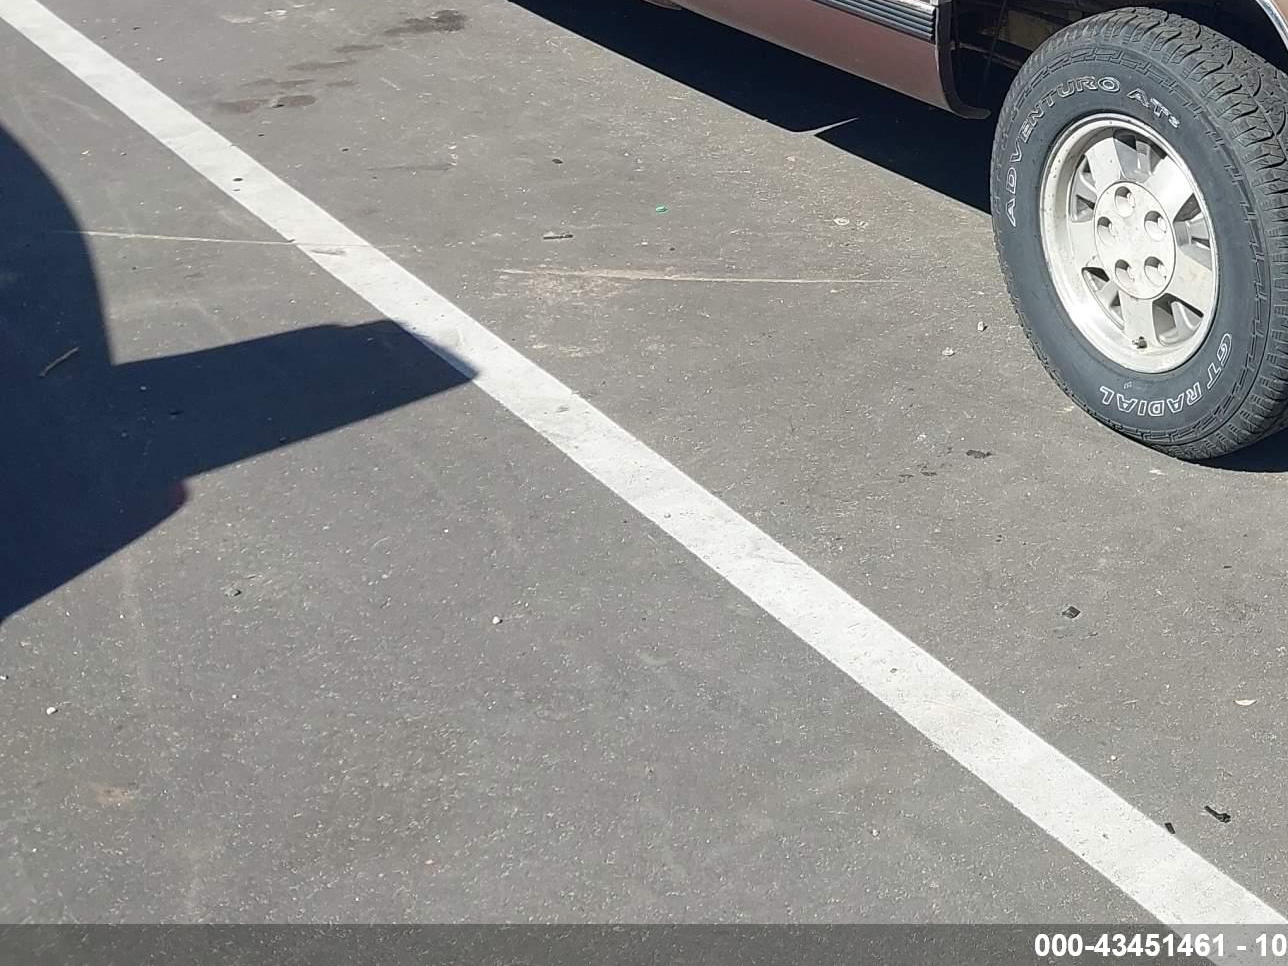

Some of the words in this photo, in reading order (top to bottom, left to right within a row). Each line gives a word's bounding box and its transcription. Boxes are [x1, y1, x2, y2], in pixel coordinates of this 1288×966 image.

[1005, 75, 1121, 227] ADVENTURO
[1206, 333, 1232, 391] GT
[1099, 381, 1202, 417] RADIAL
